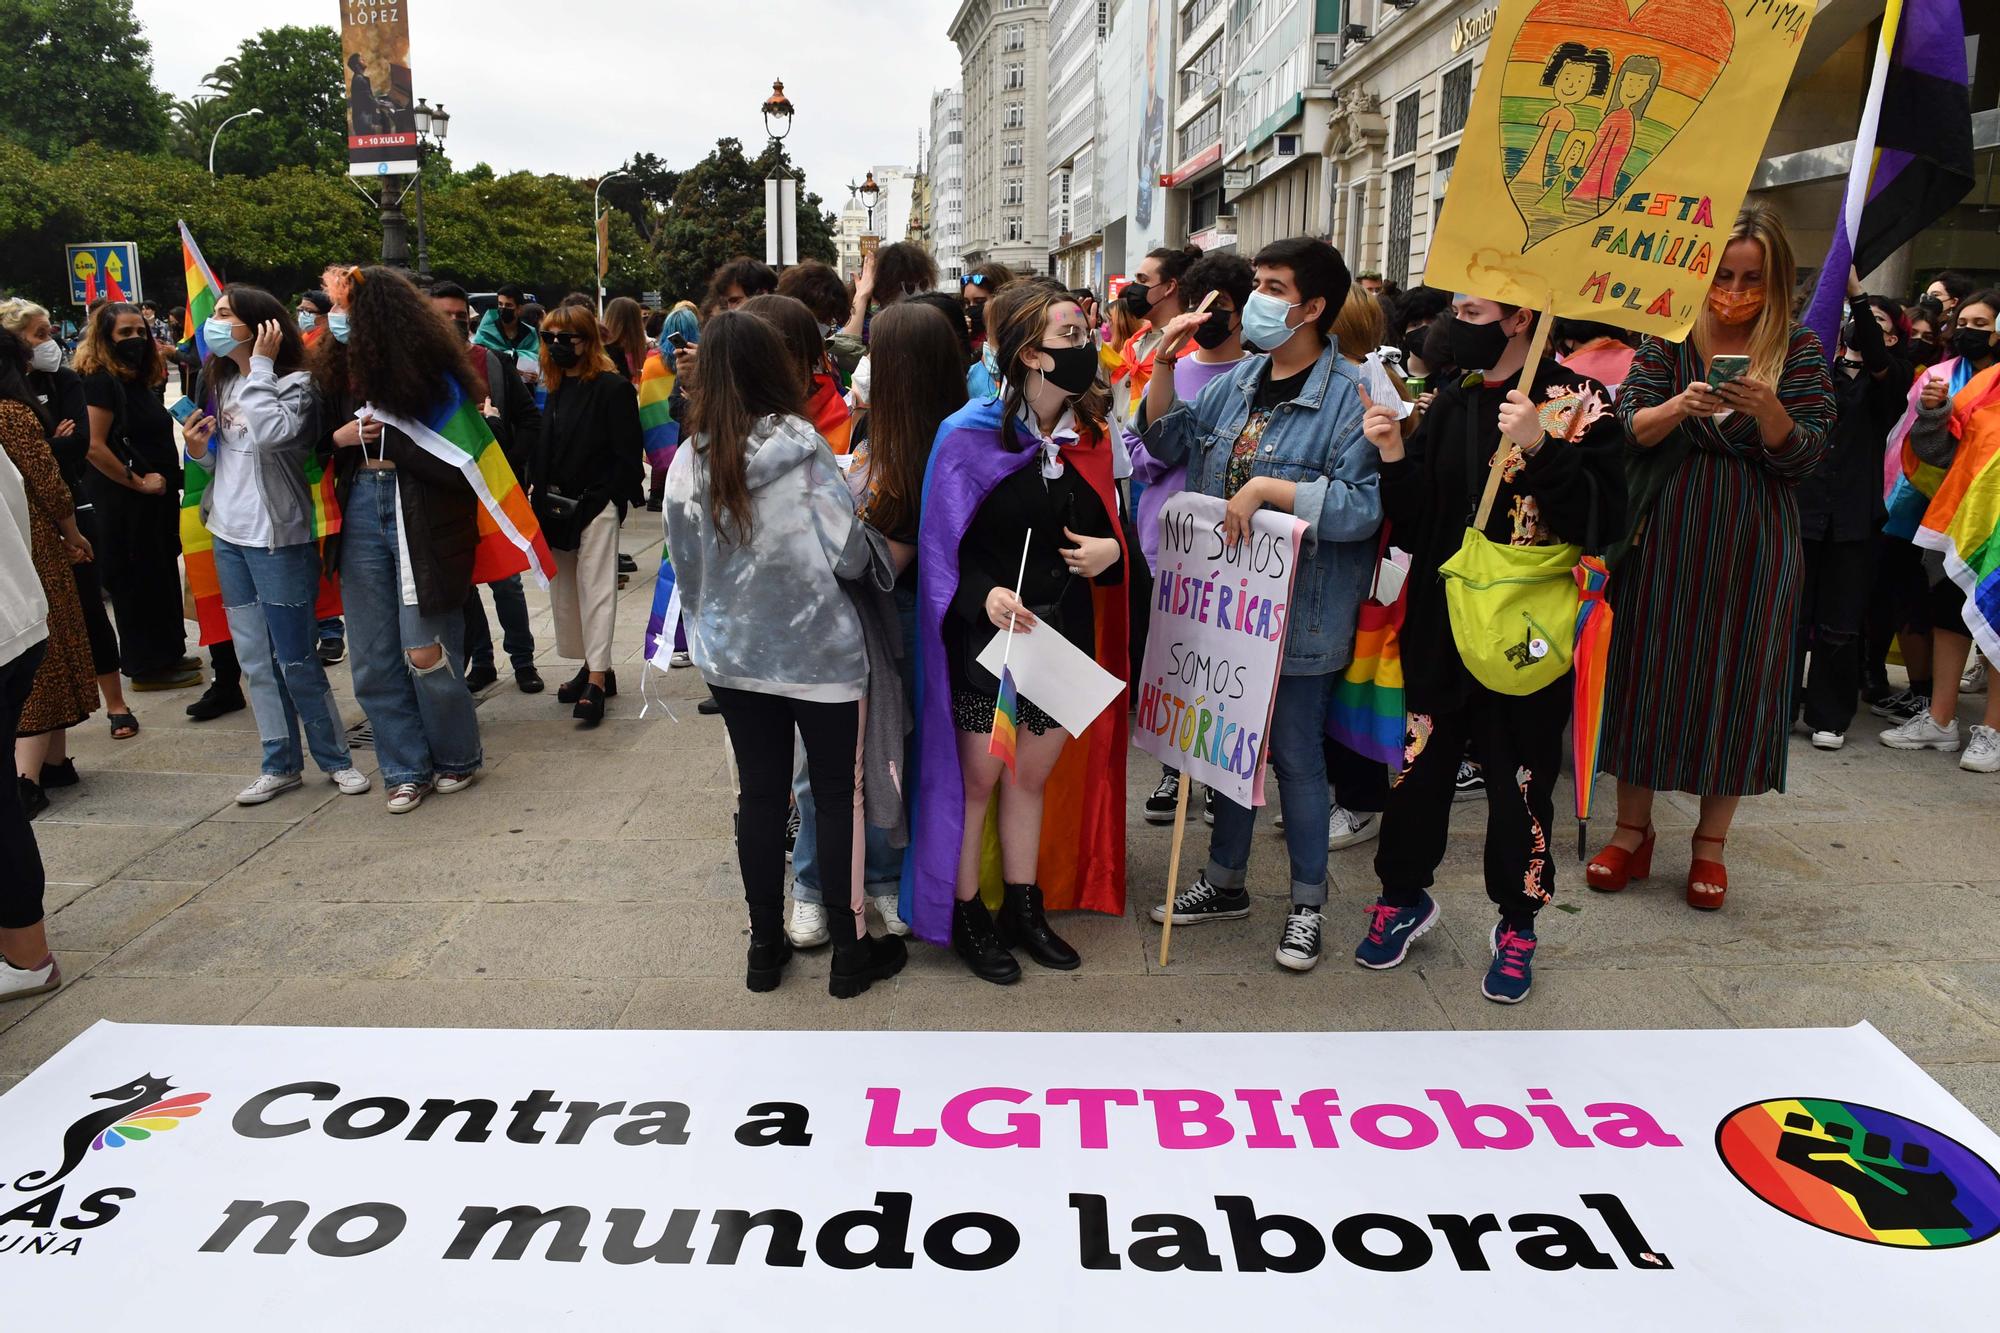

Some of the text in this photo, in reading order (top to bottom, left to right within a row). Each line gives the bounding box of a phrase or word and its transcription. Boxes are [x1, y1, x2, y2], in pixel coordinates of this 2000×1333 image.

[349, 9, 398, 25] LÓPEZ
[358, 138, 363, 146] 9
[369, 137, 378, 145] 10
[380, 136, 405, 144] XULLO
[1165, 510, 1285, 579] NO SOMOS
[1168, 642, 1247, 699] SOMOS
[232, 1081, 1683, 1151] Contra a LGTBIfobia
[0, 1184, 137, 1230] AS
[198, 1191, 1675, 1274] no mundo laboral
